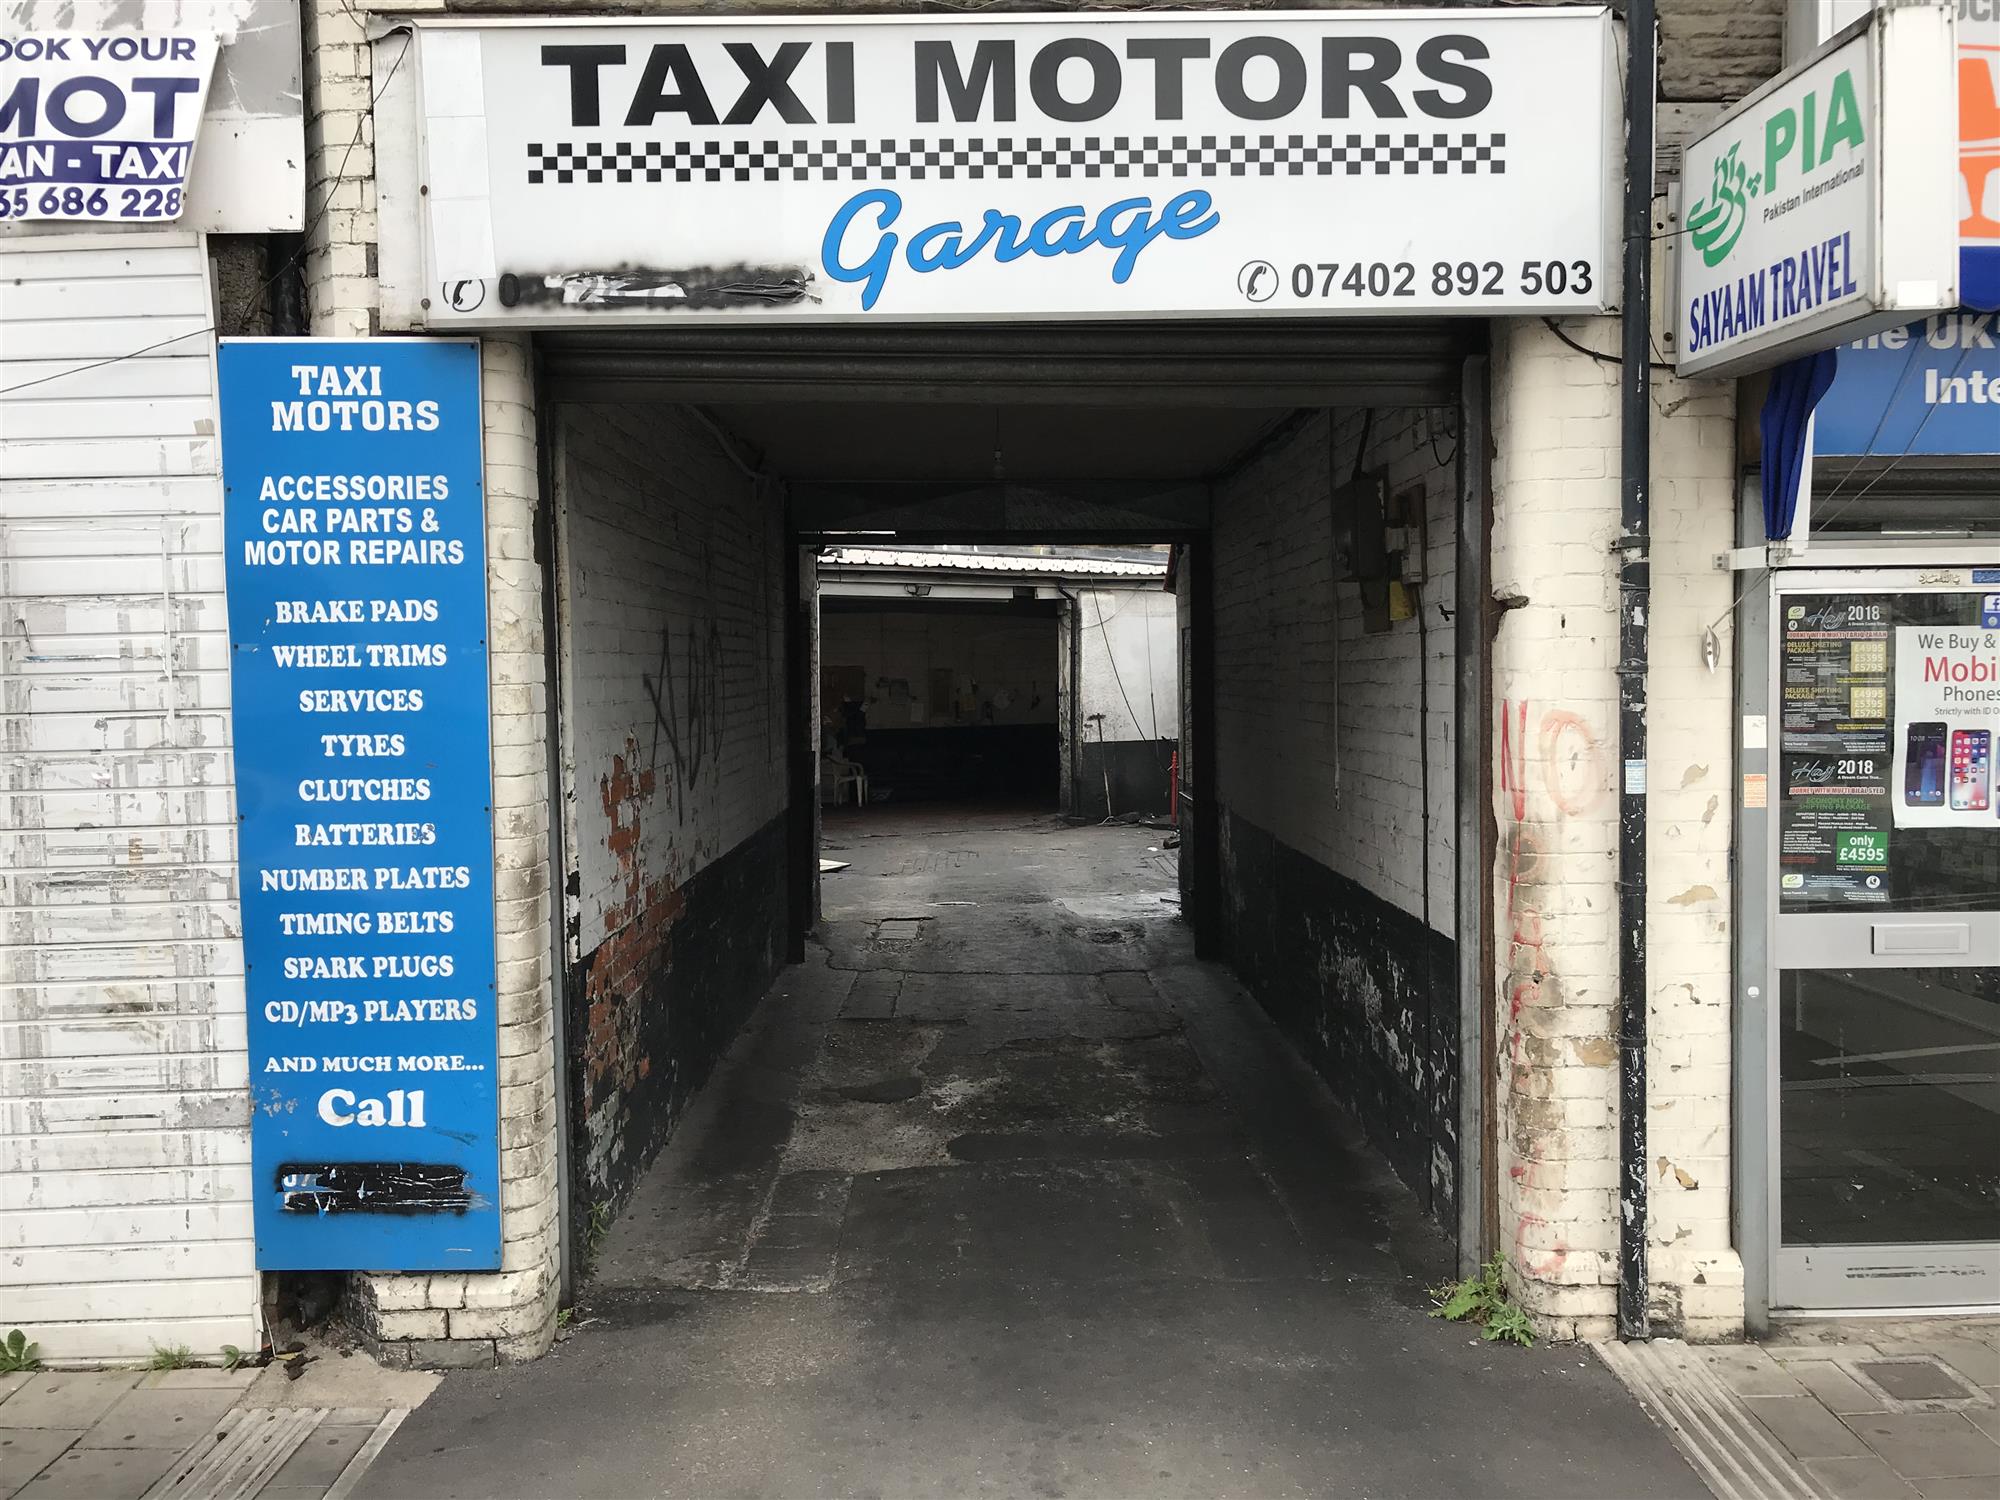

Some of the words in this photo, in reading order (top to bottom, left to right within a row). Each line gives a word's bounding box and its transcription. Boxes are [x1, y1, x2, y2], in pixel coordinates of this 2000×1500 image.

[83, 37, 196, 61] YOUR
[541, 41, 855, 126] TAXI
[915, 34, 1493, 122] MOTORS
[1764, 70, 1866, 195] PIA
[0, 145, 55, 179] AN
[92, 146, 188, 179] TAXI
[38, 187, 108, 216] 686
[120, 188, 182, 217] 228
[1763, 195, 1800, 224] Pakistan
[1802, 158, 1865, 204] International
[821, 189, 1220, 311] Garage
[1291, 262, 1416, 298] 07402
[1431, 261, 1504, 296] 892
[1520, 260, 1593, 295] 503
[1689, 268, 1766, 354] SAYAAM
[1770, 231, 1857, 323] TRAVEL
[292, 366, 382, 396] TAXI
[272, 401, 439, 432] MOTORS
[259, 475, 449, 501] ACCESSORIES
[262, 507, 318, 533] CAR
[327, 507, 413, 533] PARTS
[420, 507, 440, 532] &
[244, 540, 341, 566] MOTOR
[350, 540, 465, 565] REPAIRS
[275, 601, 364, 624] BRAKE
[370, 599, 438, 622] PADS
[1807, 606, 1846, 630] Hajj
[1847, 605, 1880, 621] 2018
[272, 645, 361, 667] WHEEL
[366, 644, 447, 666] TRIMS
[1918, 633, 1944, 649] We
[1949, 633, 1979, 653] Buy
[1984, 633, 1996, 649] &
[299, 689, 423, 712] SERVICES
[1935, 707, 1962, 717] Strictly
[1964, 707, 1981, 715] with
[1983, 707, 1991, 715] ID
[321, 734, 405, 757] TYRES
[1501, 698, 1606, 821] NO
[1791, 760, 1835, 782] Hajj
[1837, 760, 1873, 774] 2018
[298, 778, 430, 801] CLUTCHES
[295, 823, 436, 846] BATTERIES
[1849, 835, 1875, 847] only
[1839, 848, 1884, 861] £4595
[261, 869, 370, 892] NUMBER
[374, 866, 470, 889] PLATES
[279, 913, 370, 936] TIMING
[377, 911, 454, 934] BELTS
[284, 956, 367, 979] SPARK
[372, 955, 454, 977] PLUGS
[265, 1000, 358, 1028] CD/MP3
[364, 999, 477, 1023] PLAYERS
[263, 1056, 317, 1073] AND
[322, 1056, 393, 1073] MUCH
[397, 1055, 485, 1072] MORE...
[317, 1088, 427, 1128] Call
